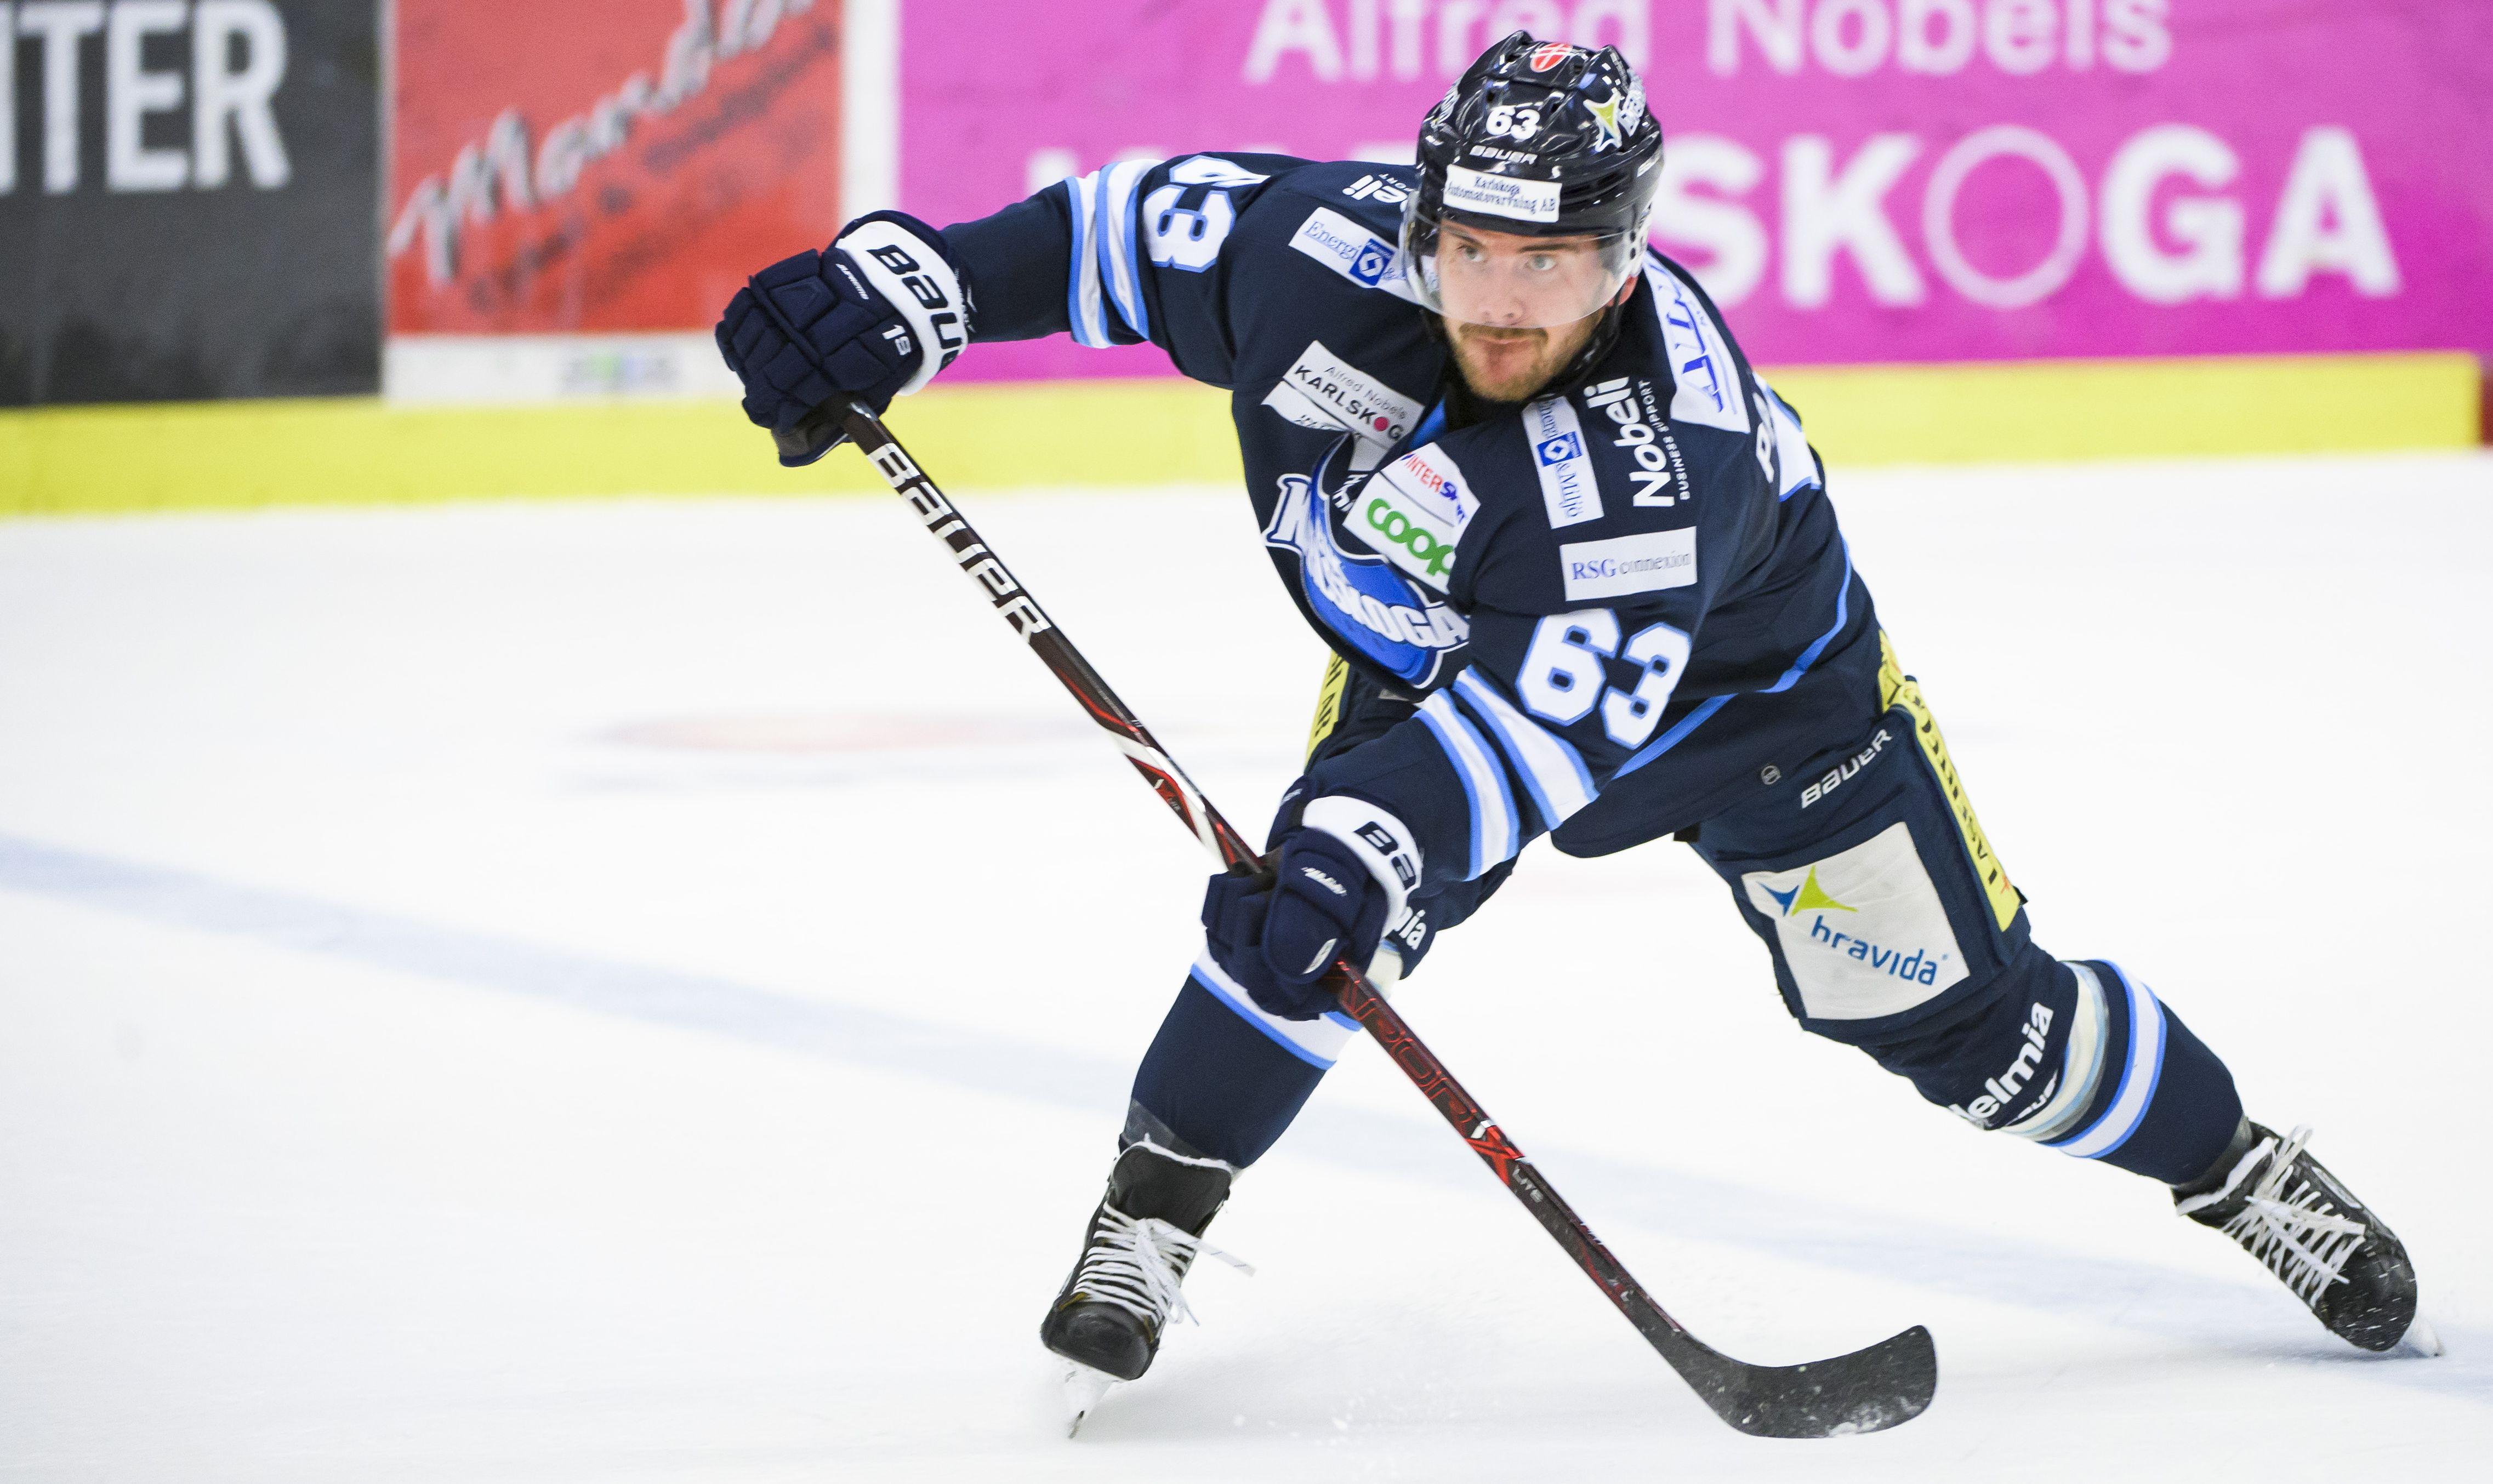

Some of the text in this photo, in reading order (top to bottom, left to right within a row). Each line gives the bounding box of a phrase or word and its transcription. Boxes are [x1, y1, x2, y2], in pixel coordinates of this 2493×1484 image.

[1705, 0, 2175, 76] Nobels
[1486, 105, 1540, 141] 63
[1028, 125, 2404, 310] SKOGA
[1306, 220, 1362, 262] Energi
[1324, 367, 1365, 392] Alfred
[1584, 376, 1674, 507] Nobeli
[865, 443, 1052, 644] BAUER
[1367, 498, 1456, 577] coop
[1572, 558, 1617, 581] RSG
[1515, 608, 1693, 750] 63
[1801, 728, 1893, 809] BAUER
